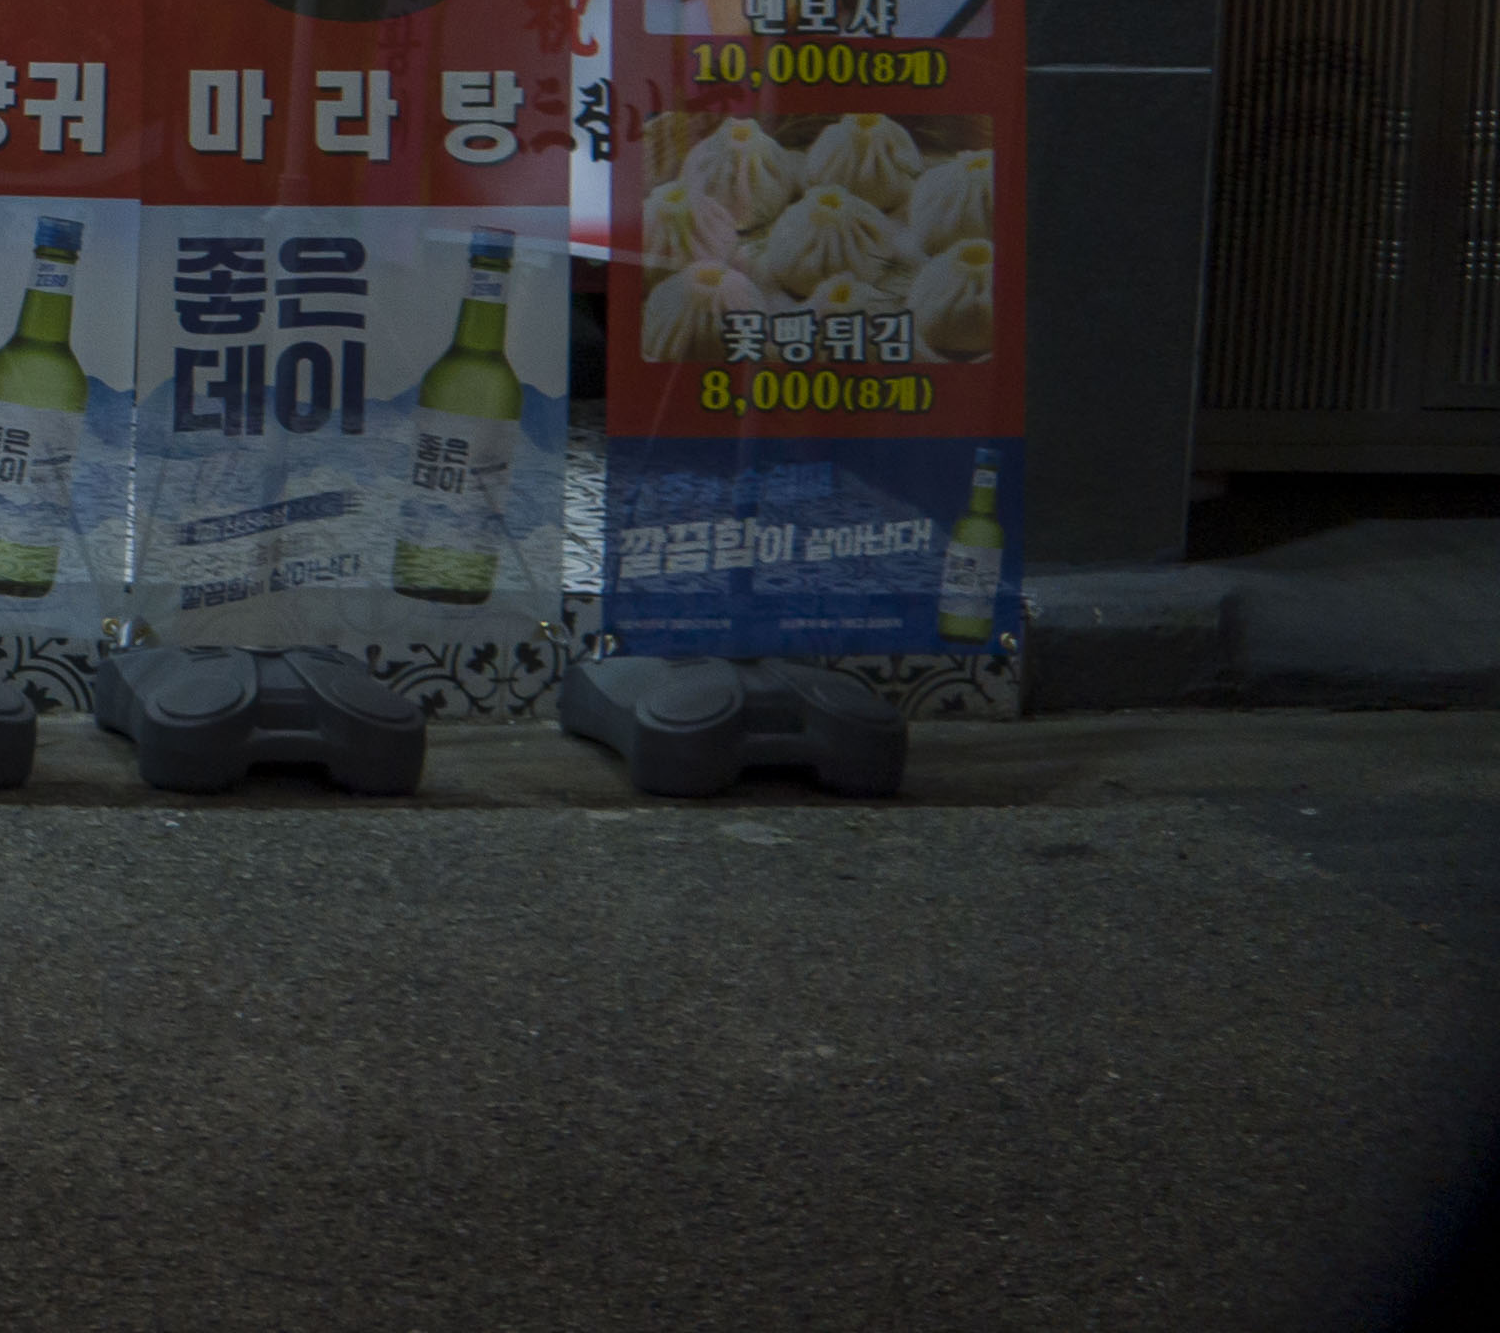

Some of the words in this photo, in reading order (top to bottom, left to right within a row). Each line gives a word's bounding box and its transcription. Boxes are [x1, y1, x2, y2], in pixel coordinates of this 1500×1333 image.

[691, 43, 949, 89] 10,000(8개)
[173, 235, 369, 335] 좋은
[722, 309, 915, 364] 꽃빵튀김
[172, 339, 367, 437] 데이
[699, 368, 935, 416] 8,000(8개)
